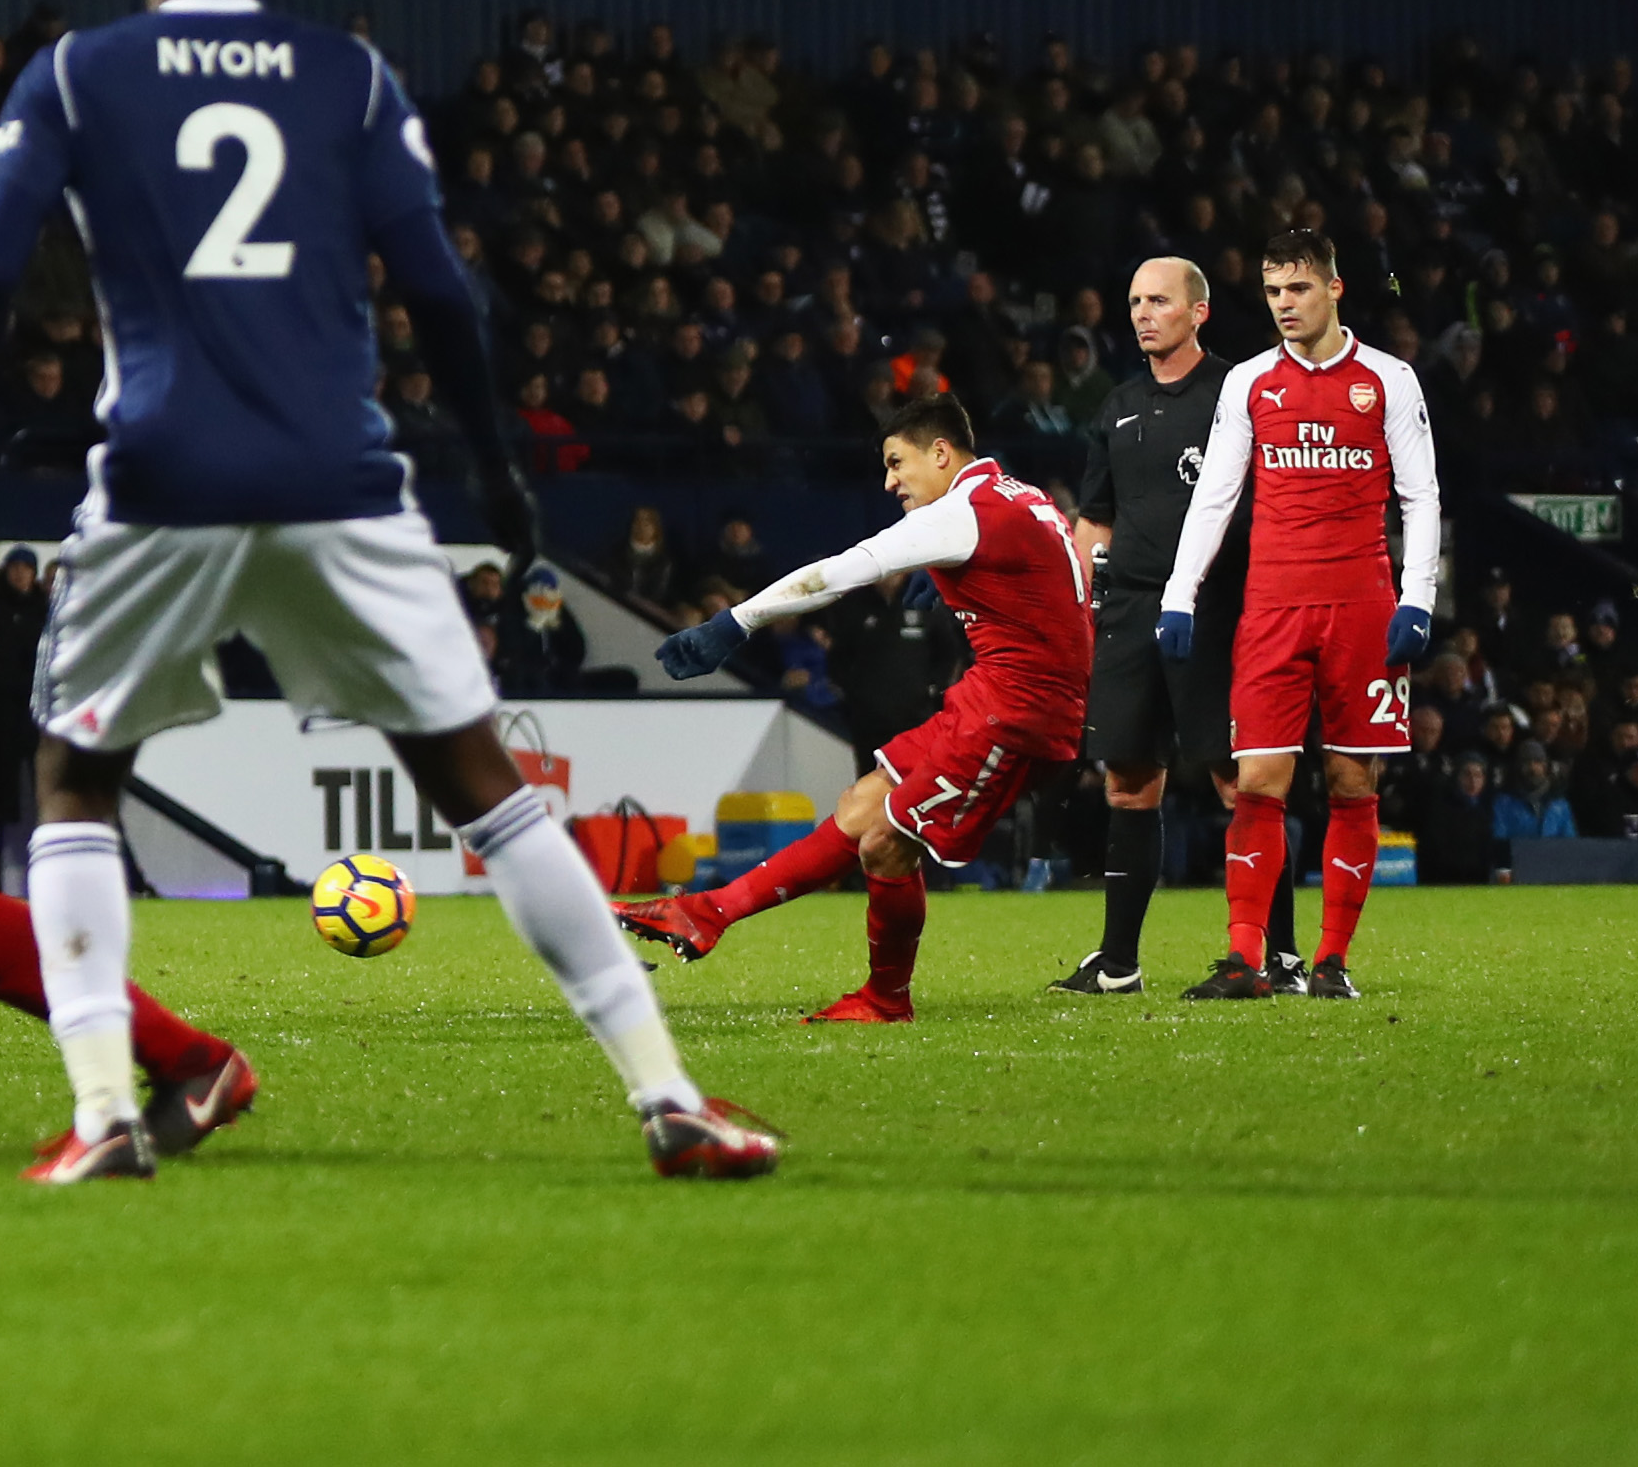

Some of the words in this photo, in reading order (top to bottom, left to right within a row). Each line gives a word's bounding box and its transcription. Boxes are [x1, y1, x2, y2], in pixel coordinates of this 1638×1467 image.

[156, 36, 293, 78] NYOM
[175, 101, 295, 279] 2
[1297, 422, 1335, 445] Fly
[1262, 441, 1374, 470] Emirates
[1028, 504, 1086, 604] 7
[1367, 676, 1411, 724] 29
[917, 775, 963, 814] 7
